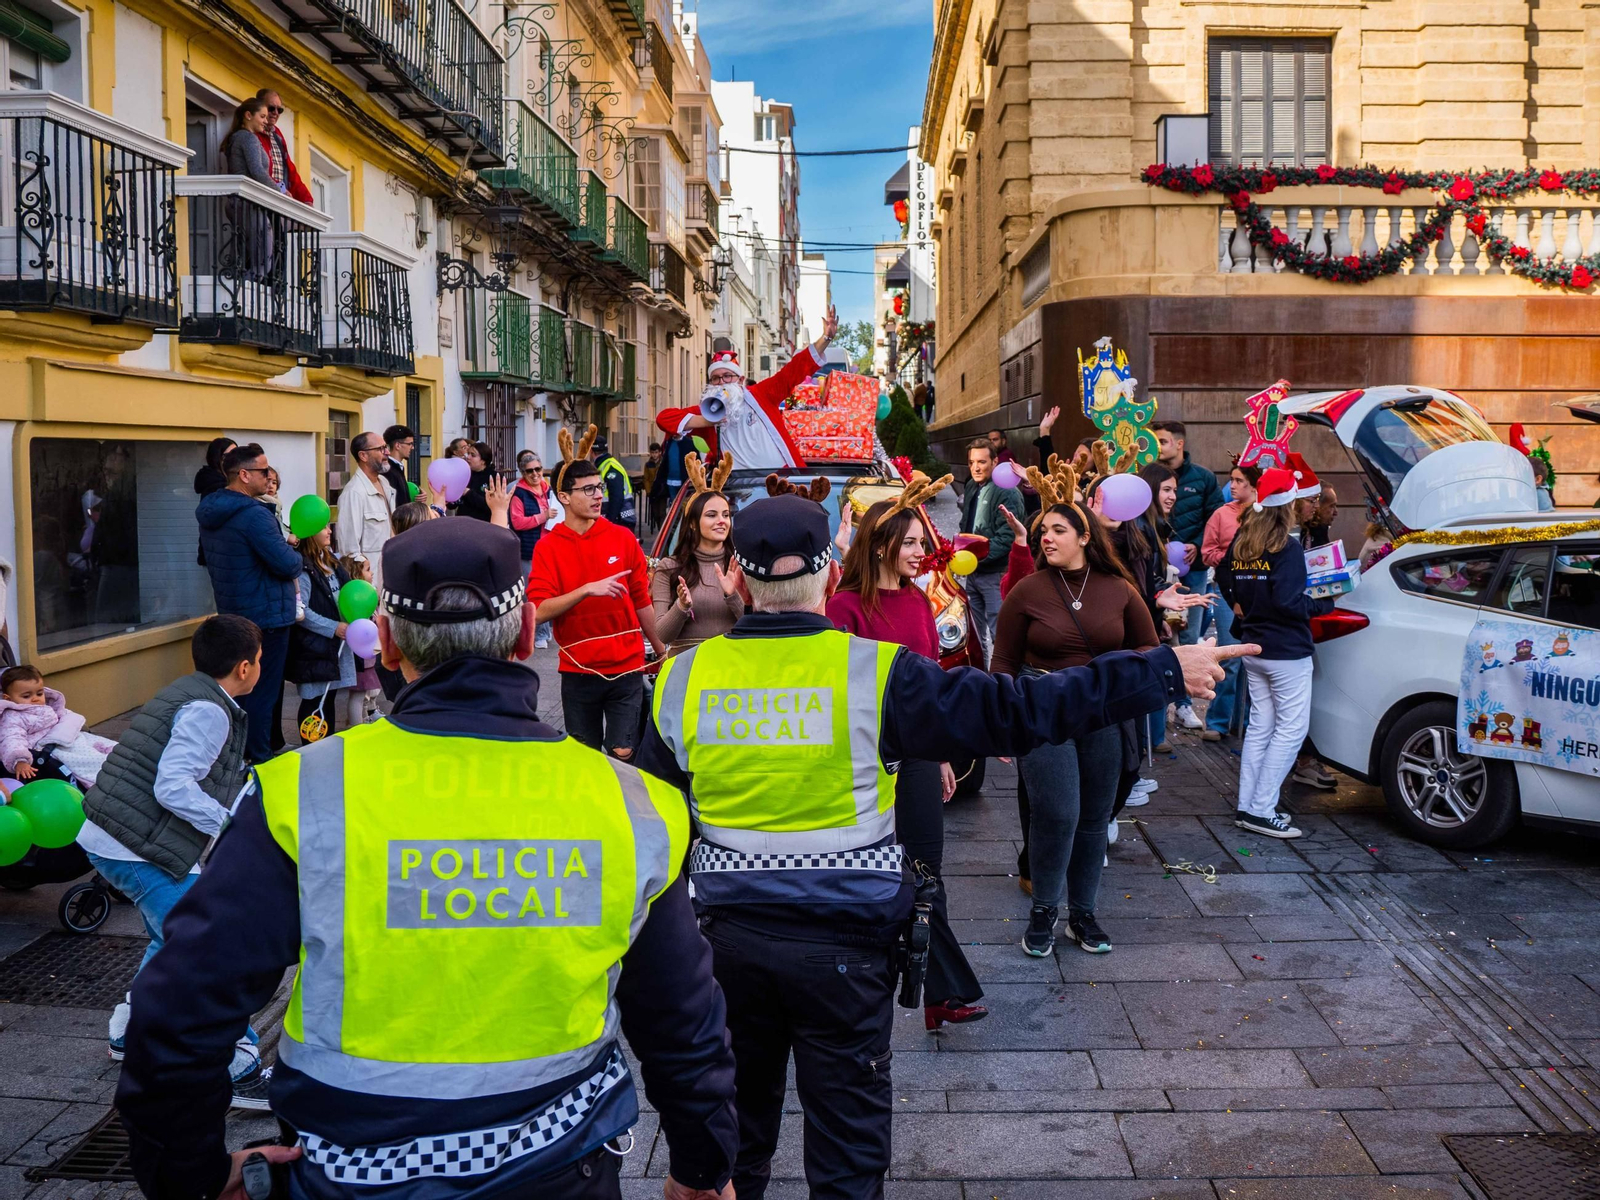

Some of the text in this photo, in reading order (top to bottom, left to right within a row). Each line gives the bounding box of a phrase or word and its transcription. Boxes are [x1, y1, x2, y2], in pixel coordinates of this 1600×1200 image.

[916, 162, 926, 250] DECORFLOR
[706, 691, 823, 714] POLICIA
[716, 718, 810, 740] LOCAL
[1562, 738, 1600, 760] HER
[401, 847, 588, 880] POLICIA
[420, 886, 569, 920] LOCAL
